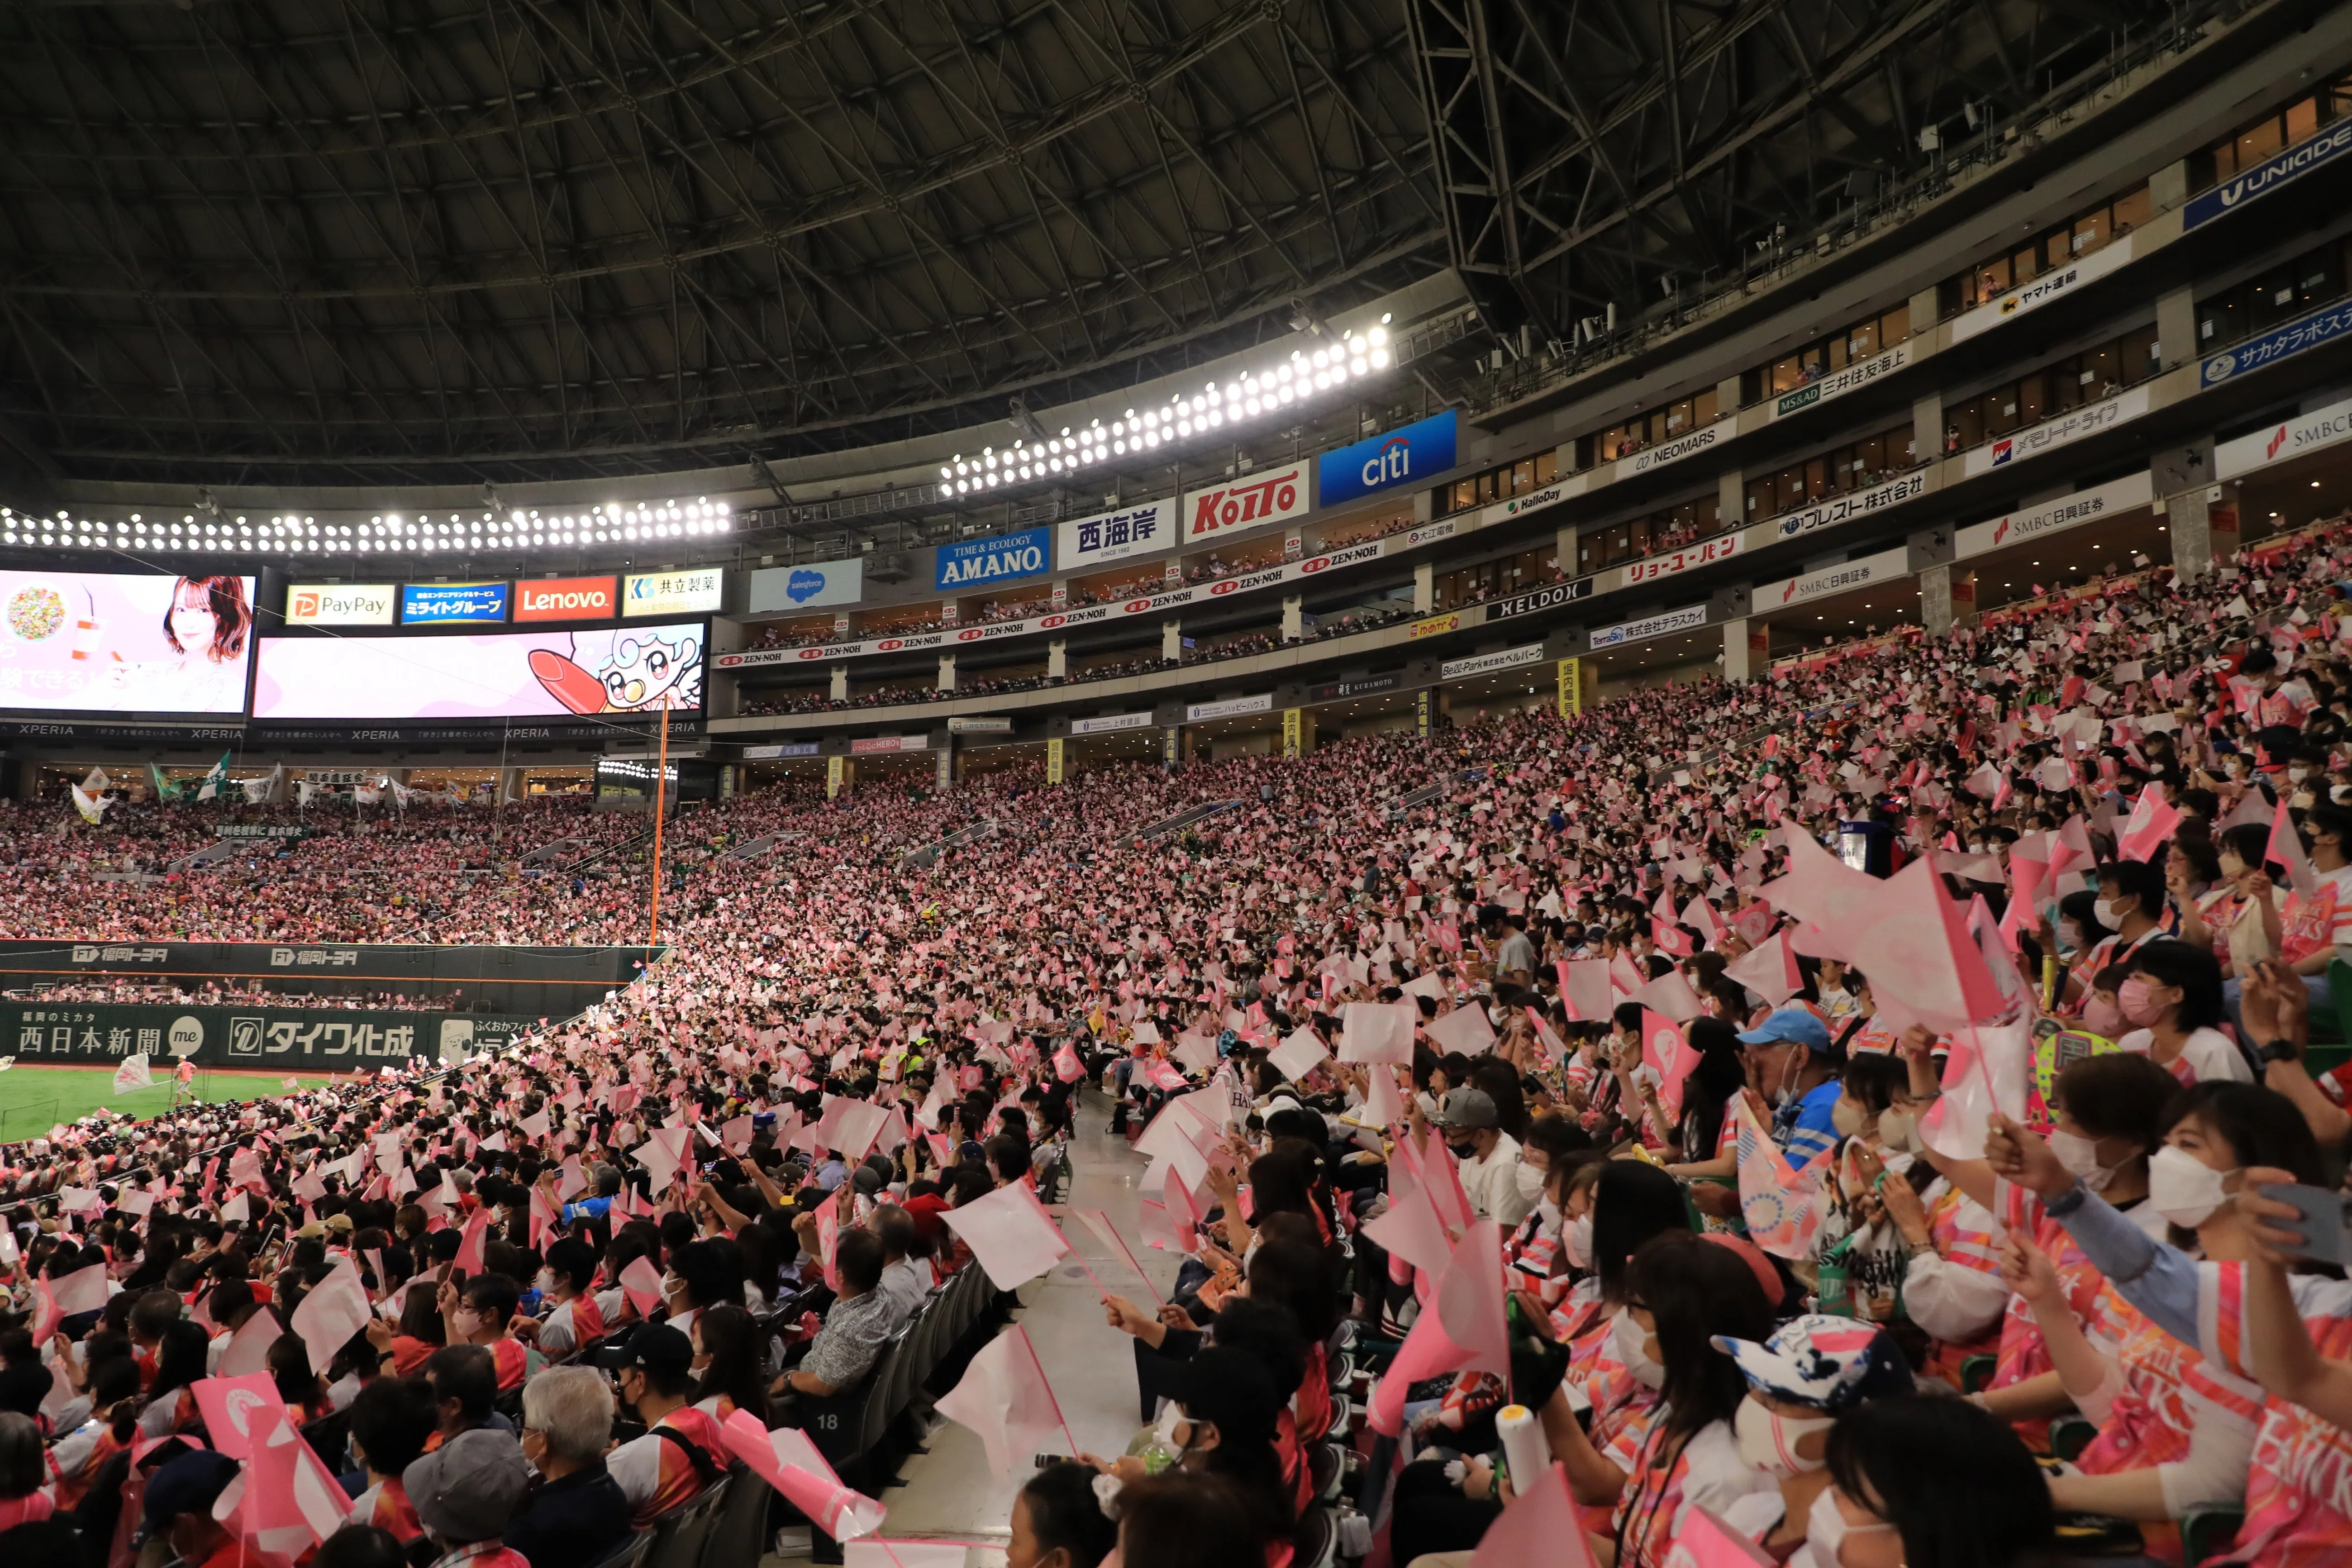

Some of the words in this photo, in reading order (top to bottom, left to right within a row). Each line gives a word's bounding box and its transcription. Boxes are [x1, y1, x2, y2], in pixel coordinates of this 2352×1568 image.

[2022, 270, 2076, 305] ヤマト運輸
[1781, 388, 1818, 411] MS&AD
[1823, 351, 1904, 396] 三井住友海上
[1654, 430, 1715, 463] NEOMARS
[1362, 437, 1409, 486] citi
[1521, 488, 1561, 510] HalloDay
[1805, 476, 1922, 529] プレスト株式会社
[1077, 507, 1157, 553] 西海岸
[1420, 523, 1454, 541] 大江電機
[954, 545, 976, 557] TIME
[979, 544, 986, 552] &
[989, 535, 1032, 551] ECOLOGY
[1331, 545, 1377, 566] ZEN-NOH
[1631, 537, 1735, 582] リョーユーパン
[941, 546, 1041, 584] AMANO
[660, 577, 714, 594] 共立製薬
[792, 580, 822, 589] salesforce
[1240, 571, 1282, 588] ZEN-NOH
[322, 597, 386, 615] PayPay
[406, 600, 501, 615] ミライトグループ
[524, 591, 605, 610] Lenovo
[1152, 591, 1192, 607] ZEN-NOH
[1066, 609, 1106, 623] ZEN-NOH
[984, 624, 1024, 636] ZEN-NOH
[1593, 631, 1624, 646] TerraSky
[1626, 611, 1705, 638] 株式会社テラスカイ
[904, 635, 942, 647] ZEN-NOH
[744, 653, 781, 663] ZEN-NOH
[824, 645, 861, 656] ZEN-NOH
[1355, 679, 1392, 690] KURAMOTO
[1563, 663, 1574, 715] 堀内電気
[19, 725, 74, 734] XPERIA
[191, 729, 243, 739] XPERIA
[352, 731, 399, 739] XPERIA
[505, 729, 549, 739] XPERIA
[753, 748, 779, 756] SHOWA
[101, 948, 168, 962] 福岡トヨタ
[297, 950, 357, 965] 福岡トヨタ
[23, 1012, 95, 1022] 福岡のミカタ
[19, 1026, 161, 1055] 西日本新聞
[174, 1031, 198, 1042] me
[266, 1022, 414, 1058] ダイワ化成
[818, 1414, 837, 1430] 18
